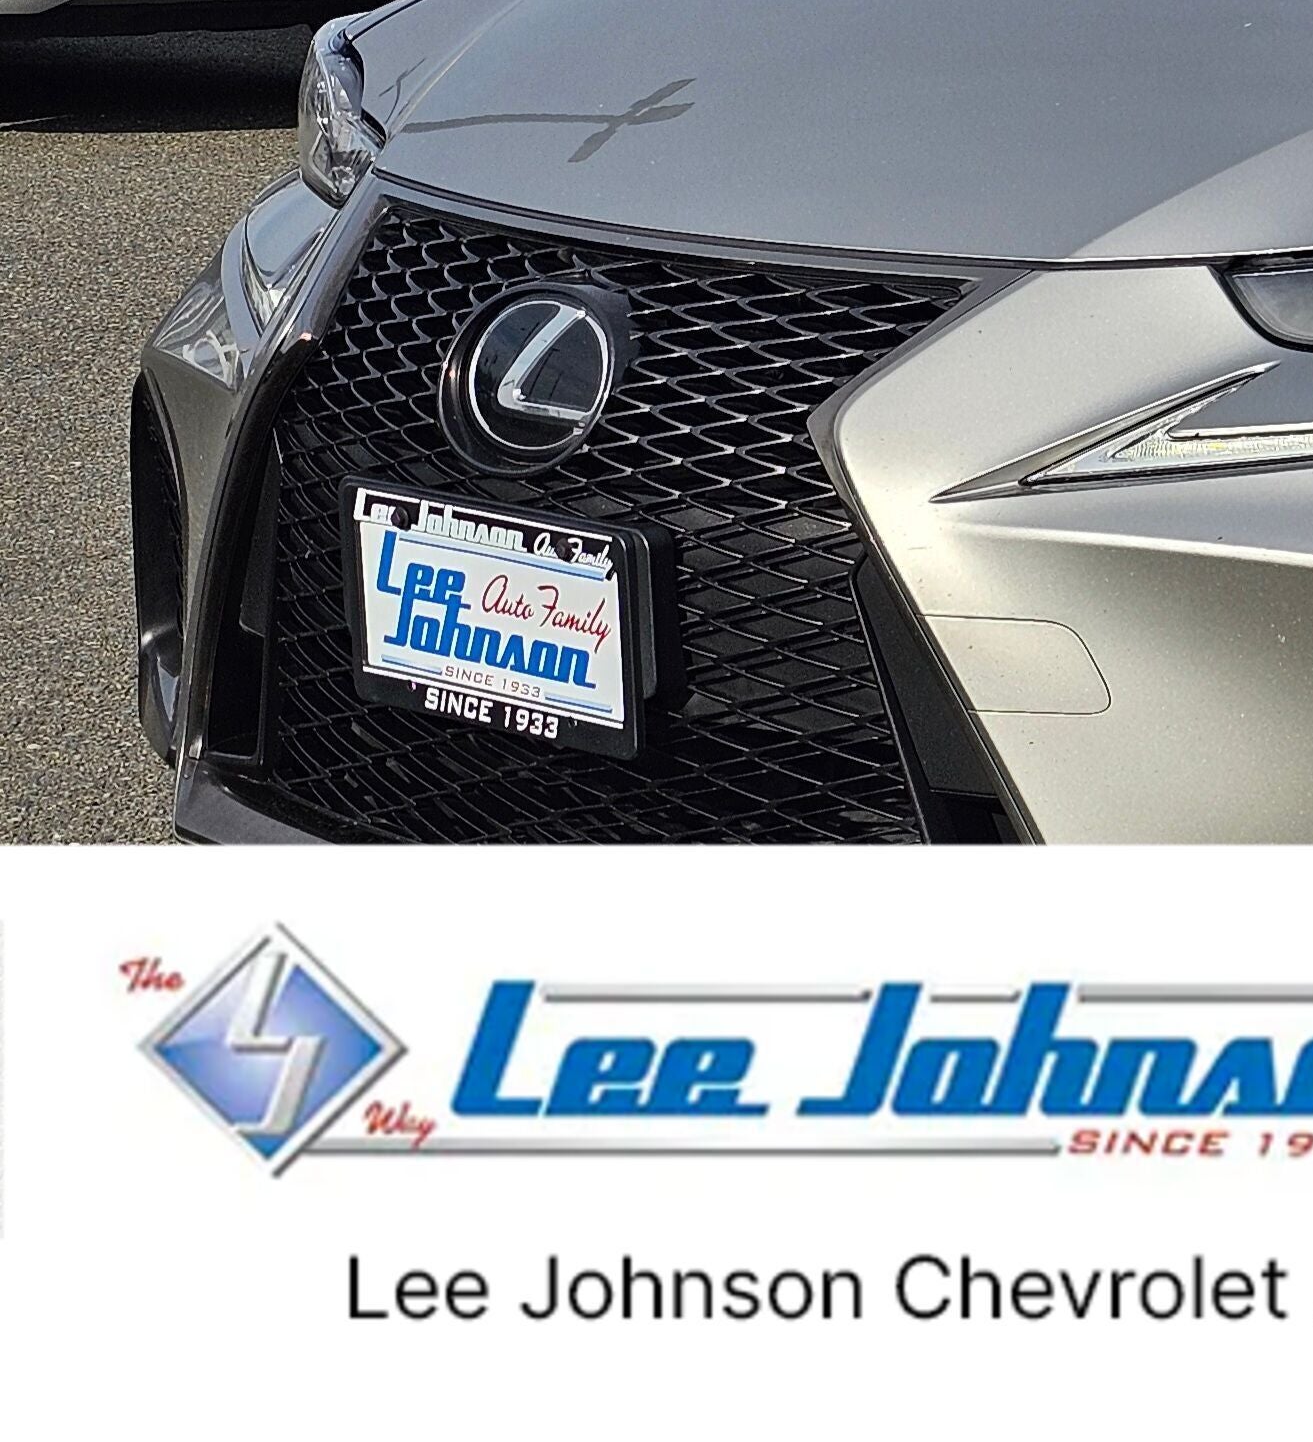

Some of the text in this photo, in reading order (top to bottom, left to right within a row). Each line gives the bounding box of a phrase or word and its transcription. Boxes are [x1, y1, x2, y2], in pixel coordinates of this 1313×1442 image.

[411, 499, 527, 552] Johnson
[566, 537, 614, 579] Family
[376, 530, 612, 654] Lee Auto Family
[383, 591, 597, 689] Johnson
[424, 688, 560, 740] SINCE 1933
[444, 665, 542, 699] SINCE 1933
